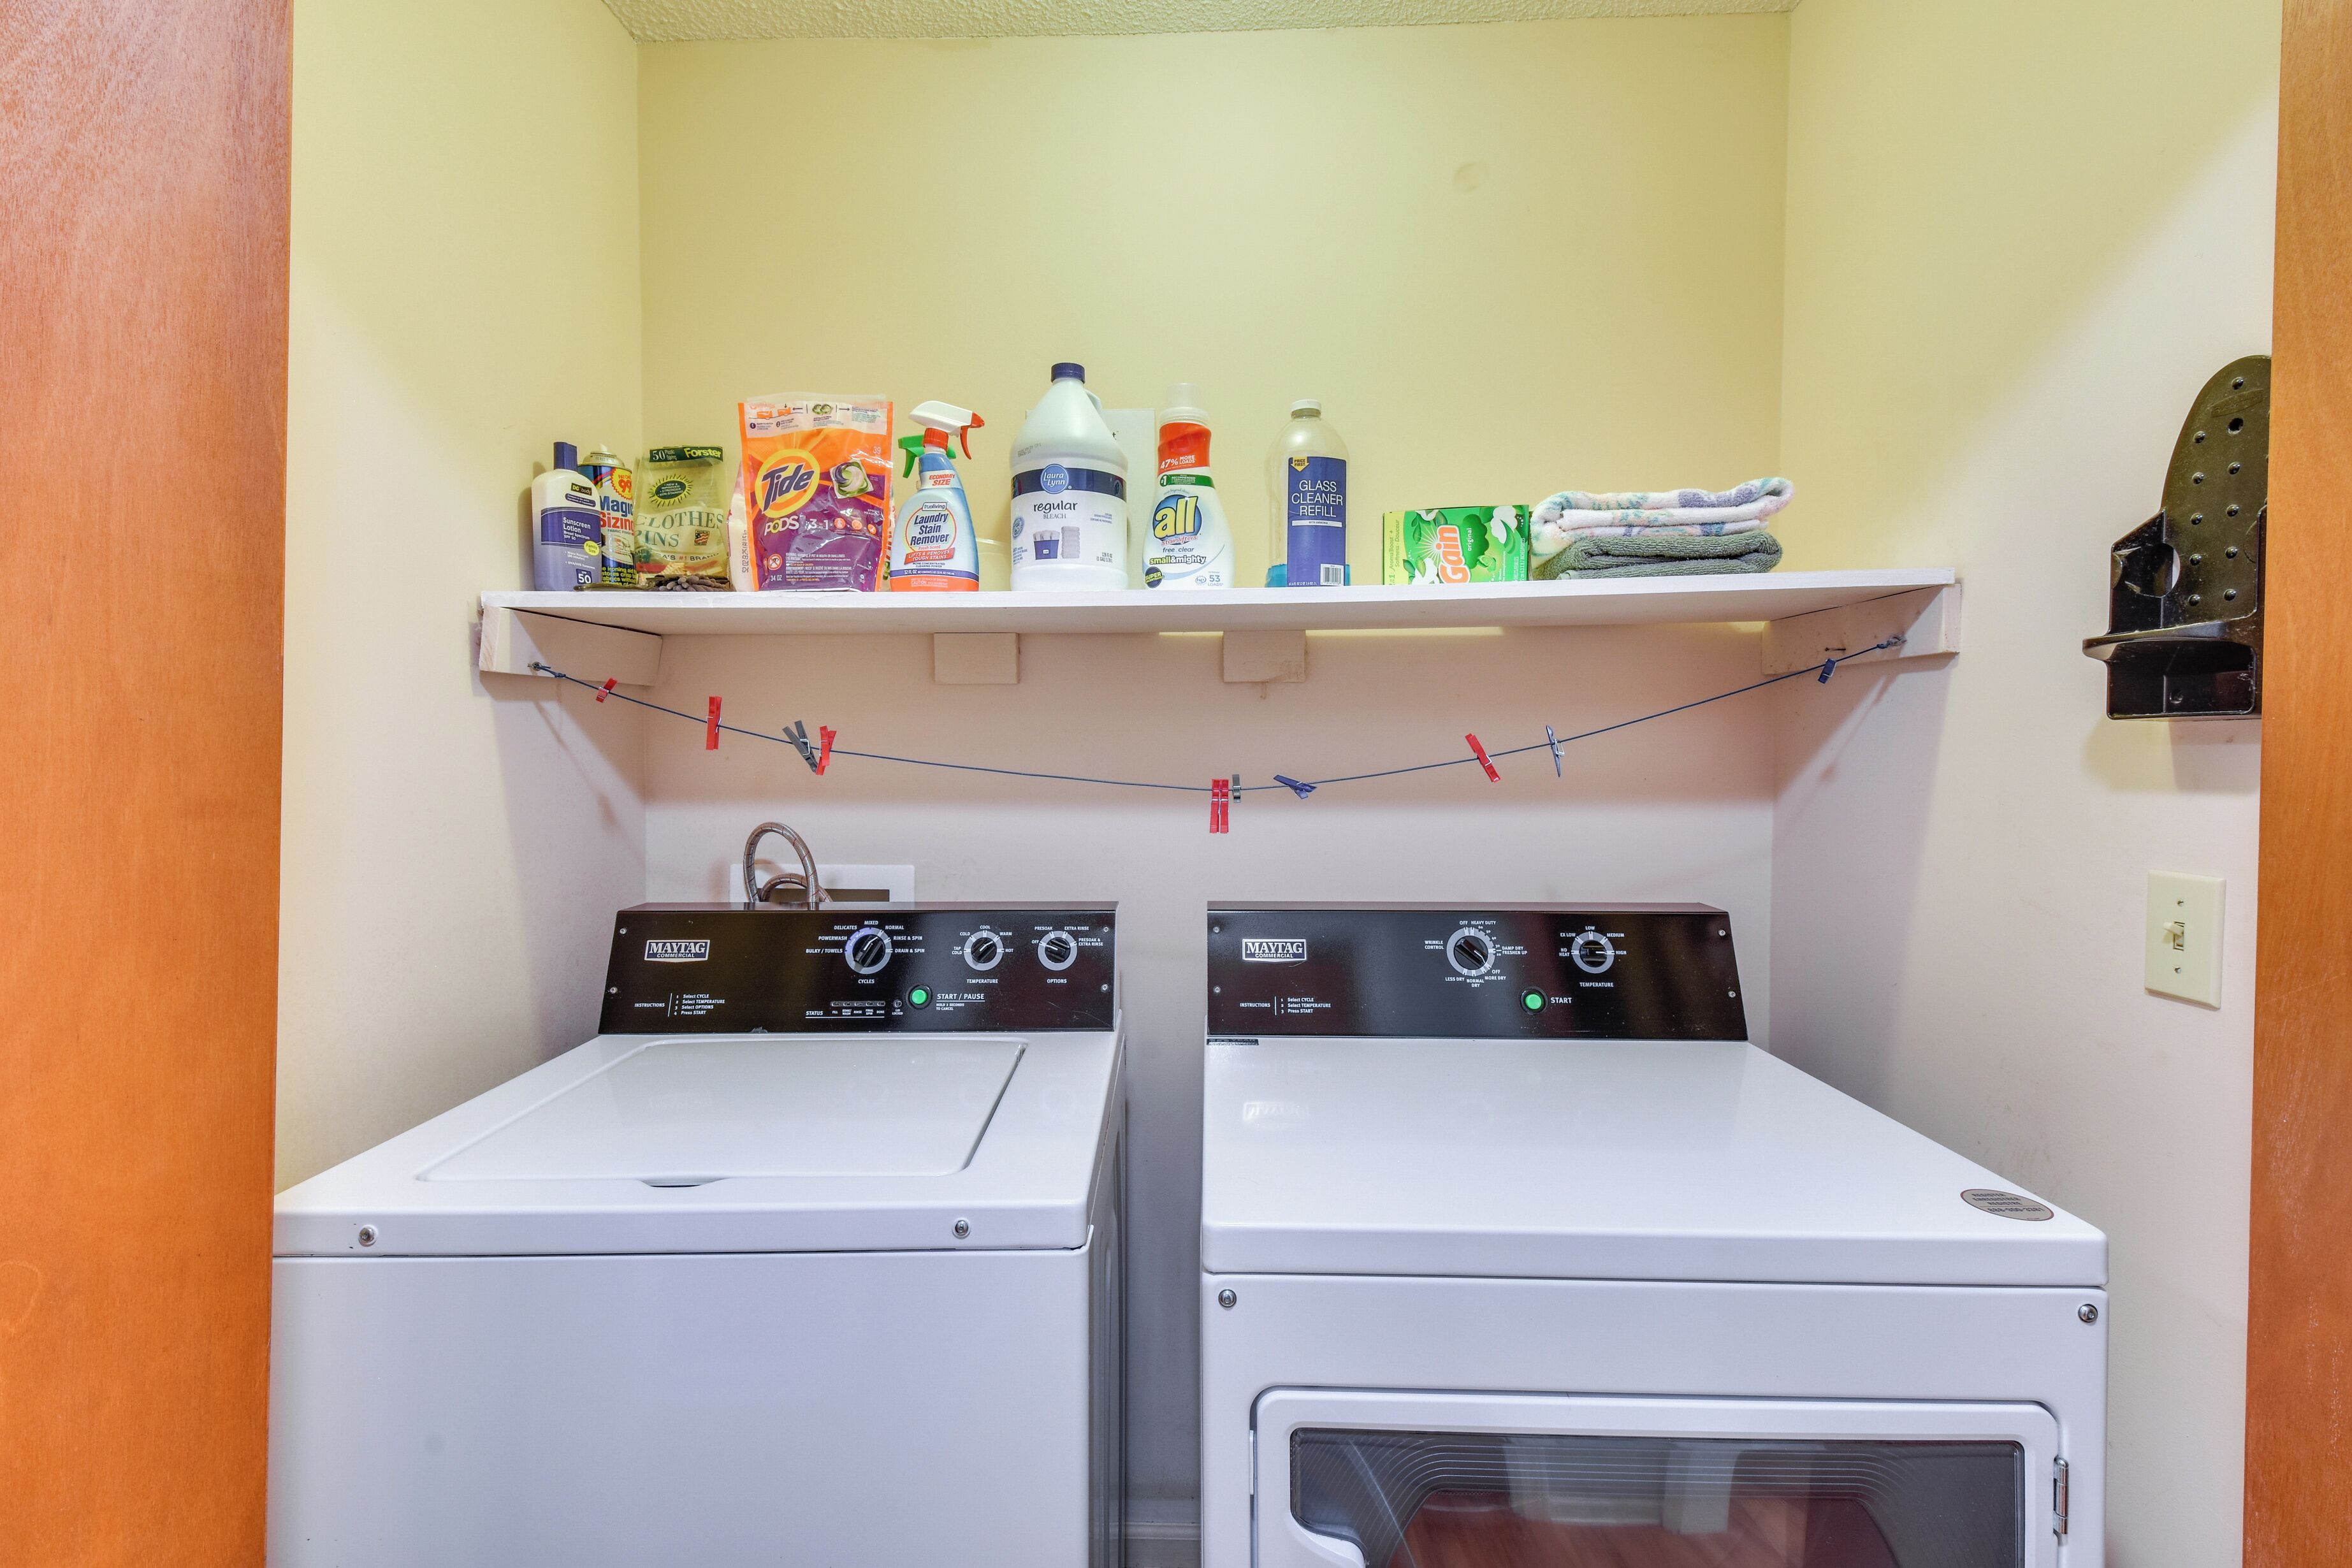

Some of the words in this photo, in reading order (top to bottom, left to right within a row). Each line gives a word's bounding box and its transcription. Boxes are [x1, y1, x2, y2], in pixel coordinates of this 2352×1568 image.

[653, 450, 665, 460] 50
[684, 448, 721, 458] Forster
[1160, 458, 1178, 469] 47%
[1043, 472, 1064, 481] Laura
[762, 463, 815, 514] Tide
[1299, 480, 1337, 492] GLASS
[1291, 493, 1342, 505] CLEANER
[600, 496, 633, 517] Magic
[1034, 500, 1078, 514] regular
[1300, 505, 1336, 517] REFILL
[563, 517, 590, 529] Sunscreen
[600, 511, 634, 536] Sizing
[635, 511, 723, 529] CLOTHES
[914, 512, 948, 525] Laundry
[1154, 496, 1198, 539] all
[563, 523, 581, 533] Lotion
[764, 516, 799, 535] PODS
[919, 524, 941, 535] Stain
[910, 534, 949, 546] Remover
[1162, 535, 1197, 546] stainlifters
[1150, 555, 1206, 565] small&mighty
[1436, 527, 1469, 583] Gain
[579, 574, 591, 583] 50
[649, 942, 706, 954] MAYTAG
[1247, 943, 1303, 953] MAYTAG
